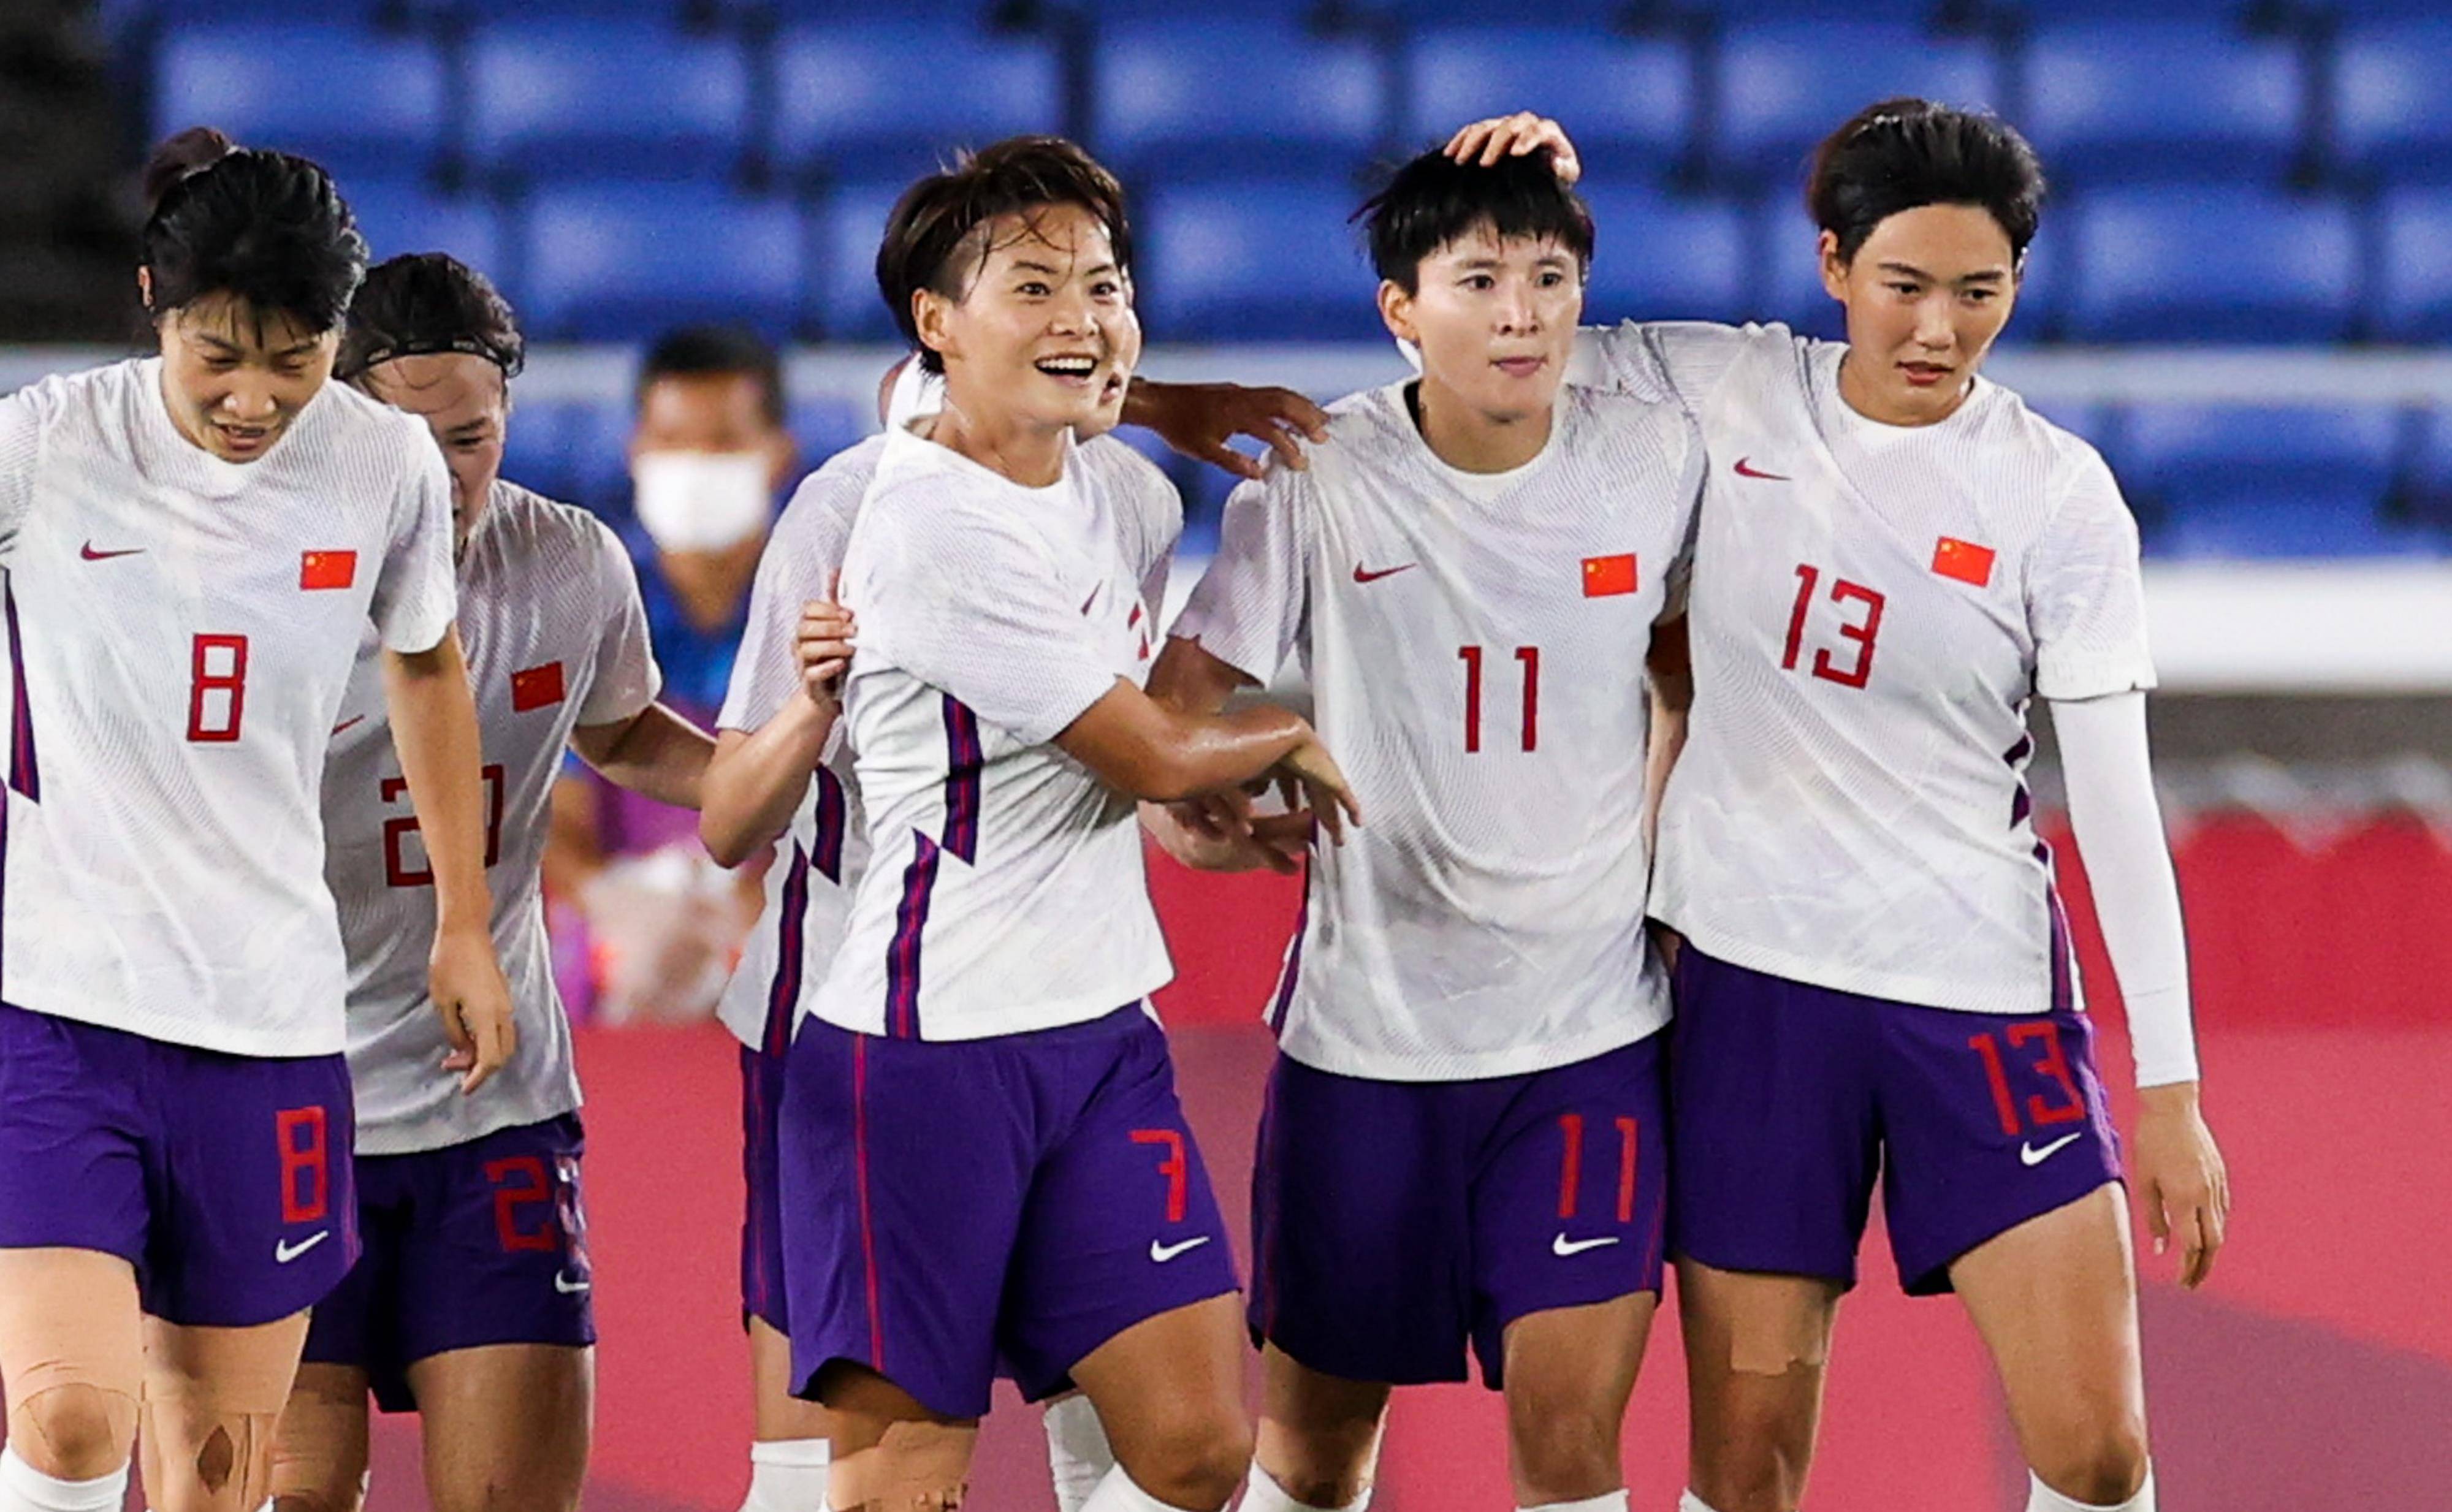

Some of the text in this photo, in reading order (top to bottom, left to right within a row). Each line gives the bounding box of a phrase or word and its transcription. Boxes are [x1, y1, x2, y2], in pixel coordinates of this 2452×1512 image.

[1783, 564, 1885, 688] 13
[187, 634, 248, 742] 8
[1460, 646, 1539, 752] 11
[1968, 1021, 2087, 1135] 13
[276, 1106, 329, 1223] 8
[1129, 1130, 1187, 1223] 7
[1559, 1114, 1638, 1221] 11
